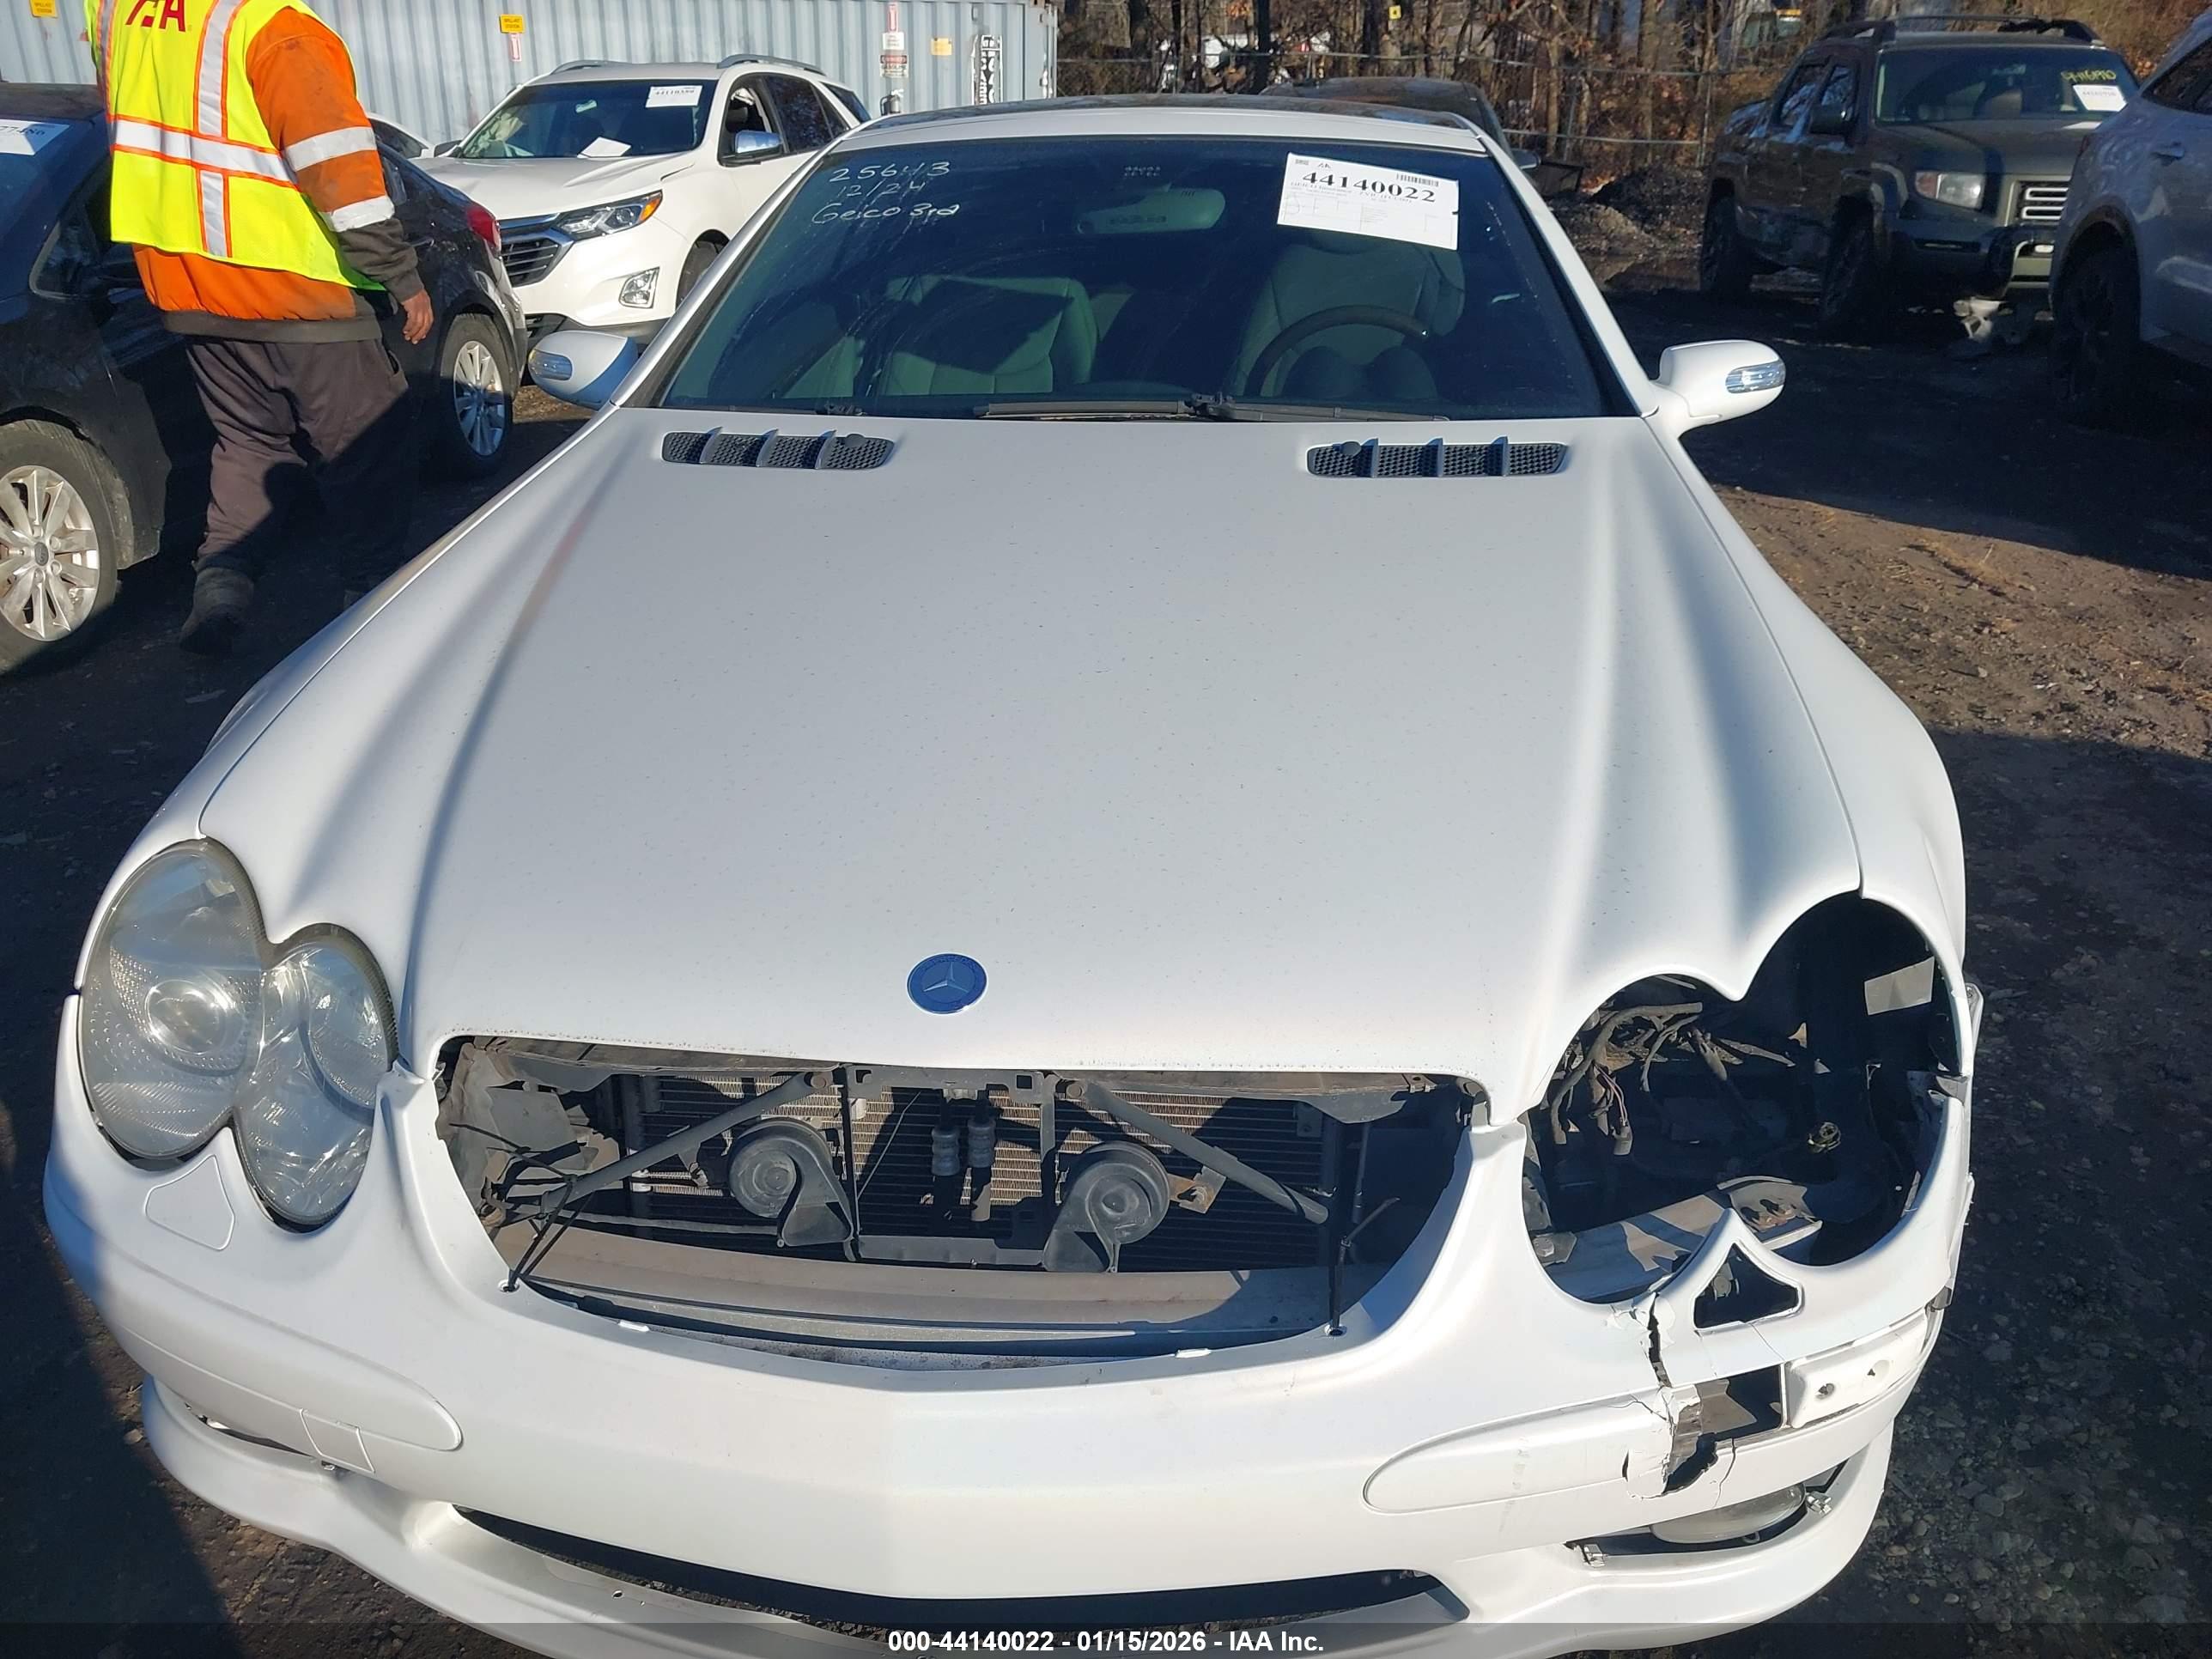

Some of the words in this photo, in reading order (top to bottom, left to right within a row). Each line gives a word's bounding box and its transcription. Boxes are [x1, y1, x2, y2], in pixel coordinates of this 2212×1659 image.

[830, 161, 951, 182] 25643
[837, 179, 926, 198] 12/24
[1302, 172, 1436, 203] 44140022
[811, 203, 902, 224] Geico
